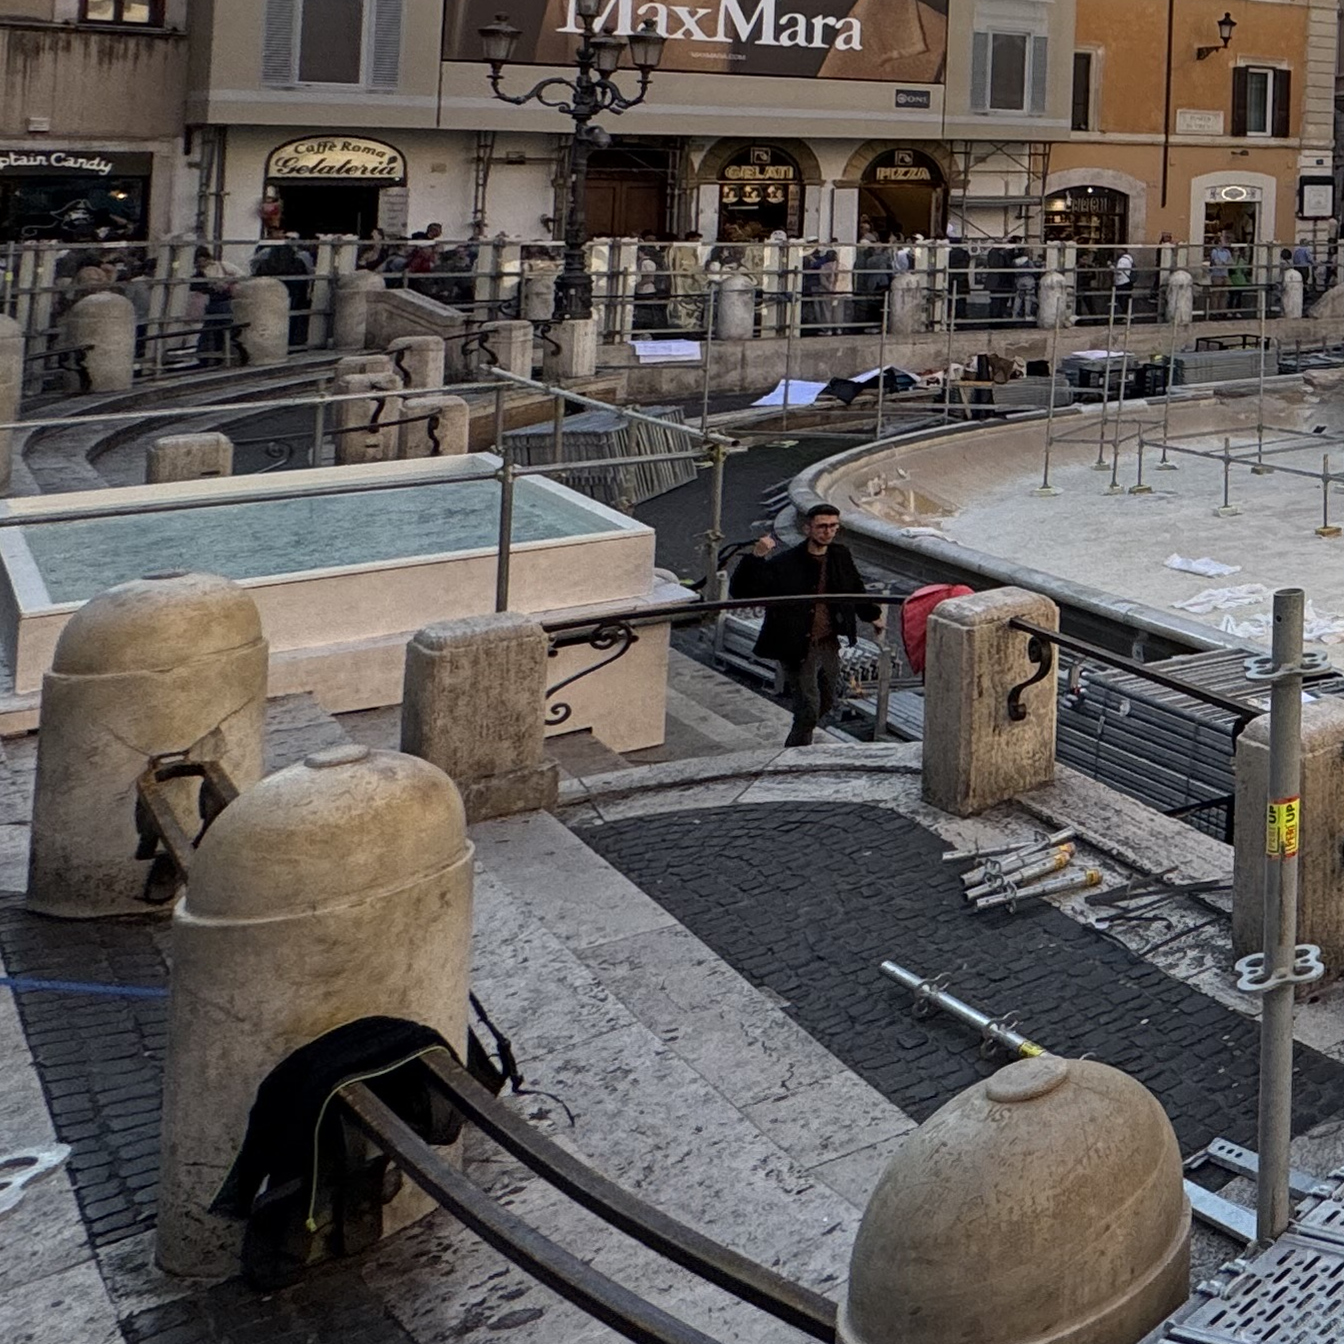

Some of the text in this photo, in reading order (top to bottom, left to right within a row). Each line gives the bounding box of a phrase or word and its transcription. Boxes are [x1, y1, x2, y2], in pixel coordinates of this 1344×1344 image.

[340, 140, 387, 159] Roma
[50, 152, 113, 175] Candy
[274, 156, 396, 176] Gelateria
[724, 165, 794, 180] GELATI
[876, 166, 931, 181] PIZZA
